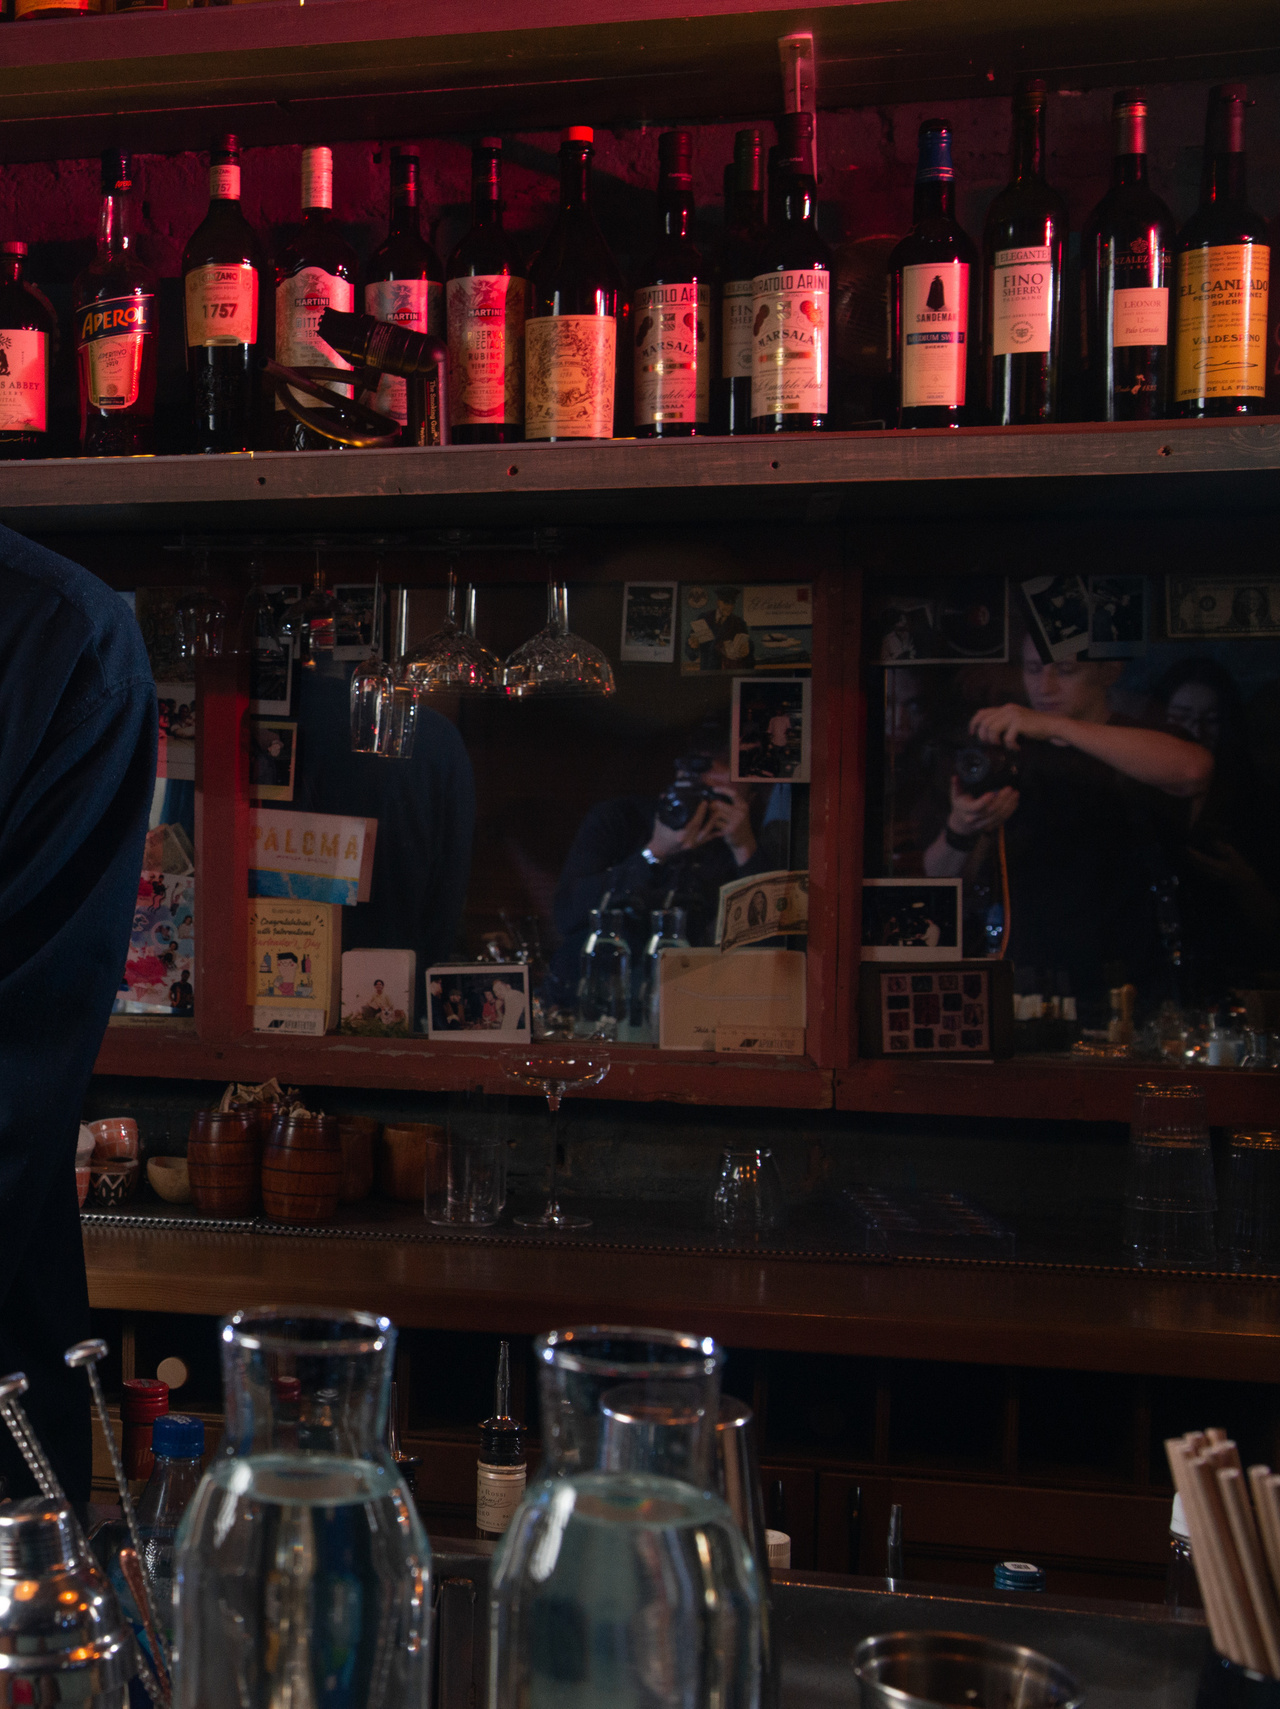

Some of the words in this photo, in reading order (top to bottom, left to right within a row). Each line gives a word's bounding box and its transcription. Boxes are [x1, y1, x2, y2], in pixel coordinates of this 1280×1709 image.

[1001, 249, 1047, 262] ELEGANTE
[797, 272, 828, 291] ARINI
[1003, 273, 1043, 288] FINO
[1002, 285, 1043, 298] SHERRY
[1180, 284, 1197, 298] EL
[1192, 293, 1224, 302] PEDRO
[295, 298, 329, 306] MARTINI
[1124, 300, 1161, 309] LEONOR
[202, 303, 238, 319] 1757
[731, 304, 753, 317] FIN
[81, 305, 147, 340] APEROL
[758, 328, 814, 348] MARSALA
[468, 352, 503, 360] RUBINO
[9, 381, 40, 391] ABBEY
[251, 825, 358, 861] PALOMA
